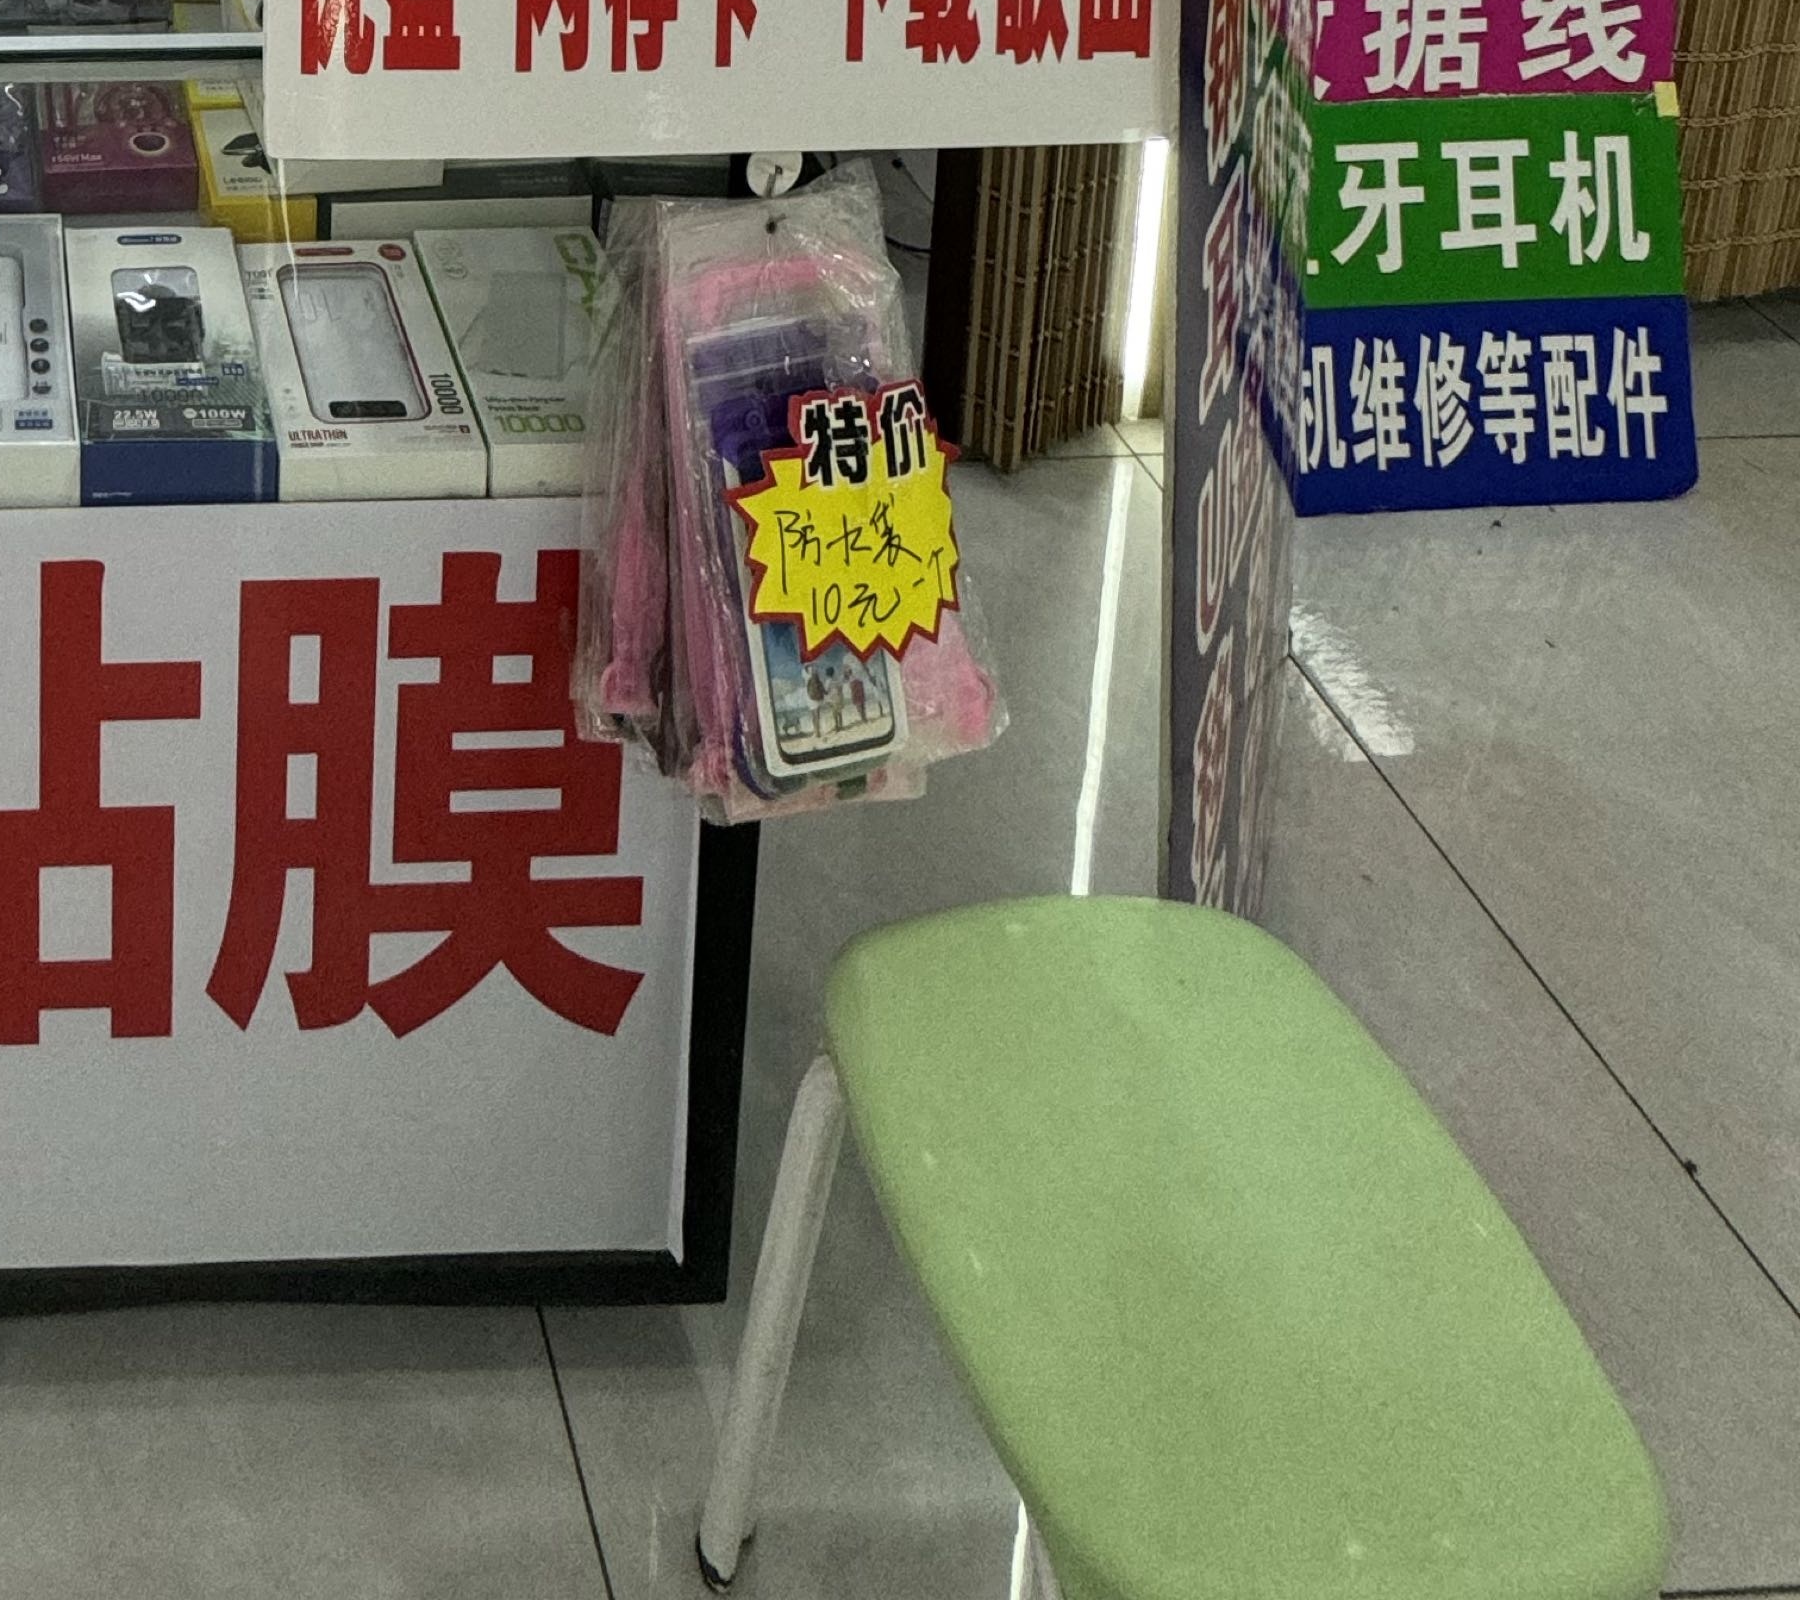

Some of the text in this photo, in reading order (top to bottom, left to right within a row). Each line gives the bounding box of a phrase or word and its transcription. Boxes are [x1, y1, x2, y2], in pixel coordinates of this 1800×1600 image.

[1306, 130, 1651, 278] 牙耳机
[494, 413, 586, 434] 10000
[803, 384, 928, 489] 特价
